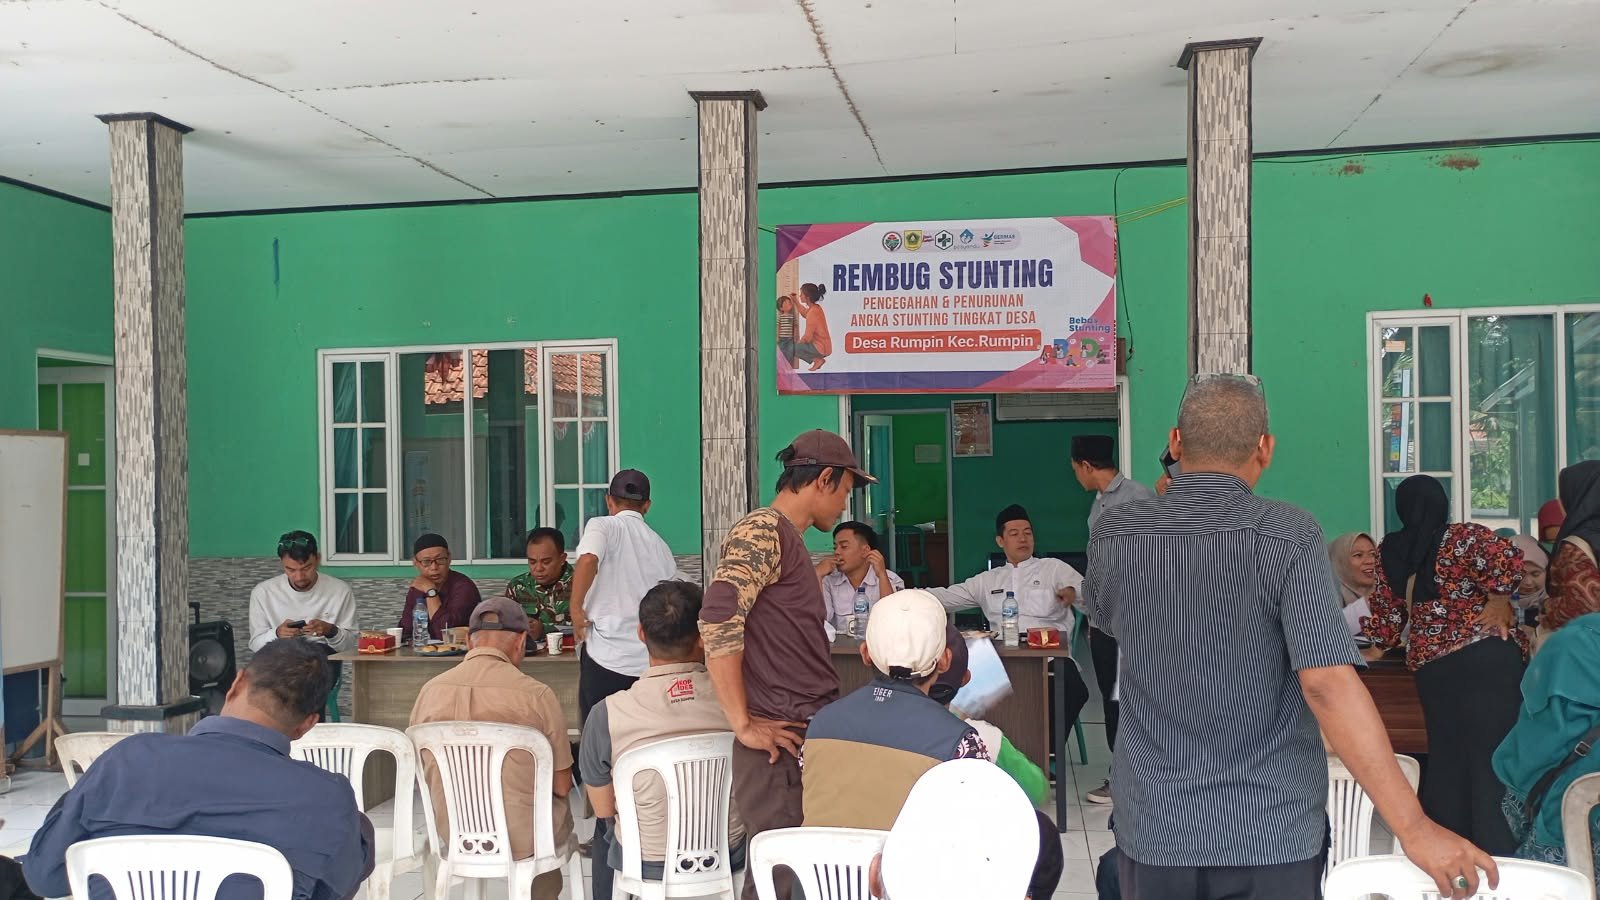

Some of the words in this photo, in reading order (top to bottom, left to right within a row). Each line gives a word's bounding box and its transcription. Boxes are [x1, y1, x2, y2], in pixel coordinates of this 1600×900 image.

[833, 262, 931, 291] REMBUG
[939, 259, 1053, 289] STUNTING
[863, 296, 939, 310] PENCEGAHAN
[943, 295, 950, 308] &
[953, 293, 1024, 308] PENURUNAN
[850, 313, 889, 327] ANGKA
[892, 312, 949, 326] STUNTING
[953, 311, 1002, 325] TINGKAT
[1006, 310, 1037, 324] DESA
[1069, 316, 1099, 325] Bebas
[1069, 325, 1111, 334] Stunting
[852, 337, 887, 349] Desa
[890, 335, 944, 352] Rumpin
[873, 687, 893, 698] EIGER
